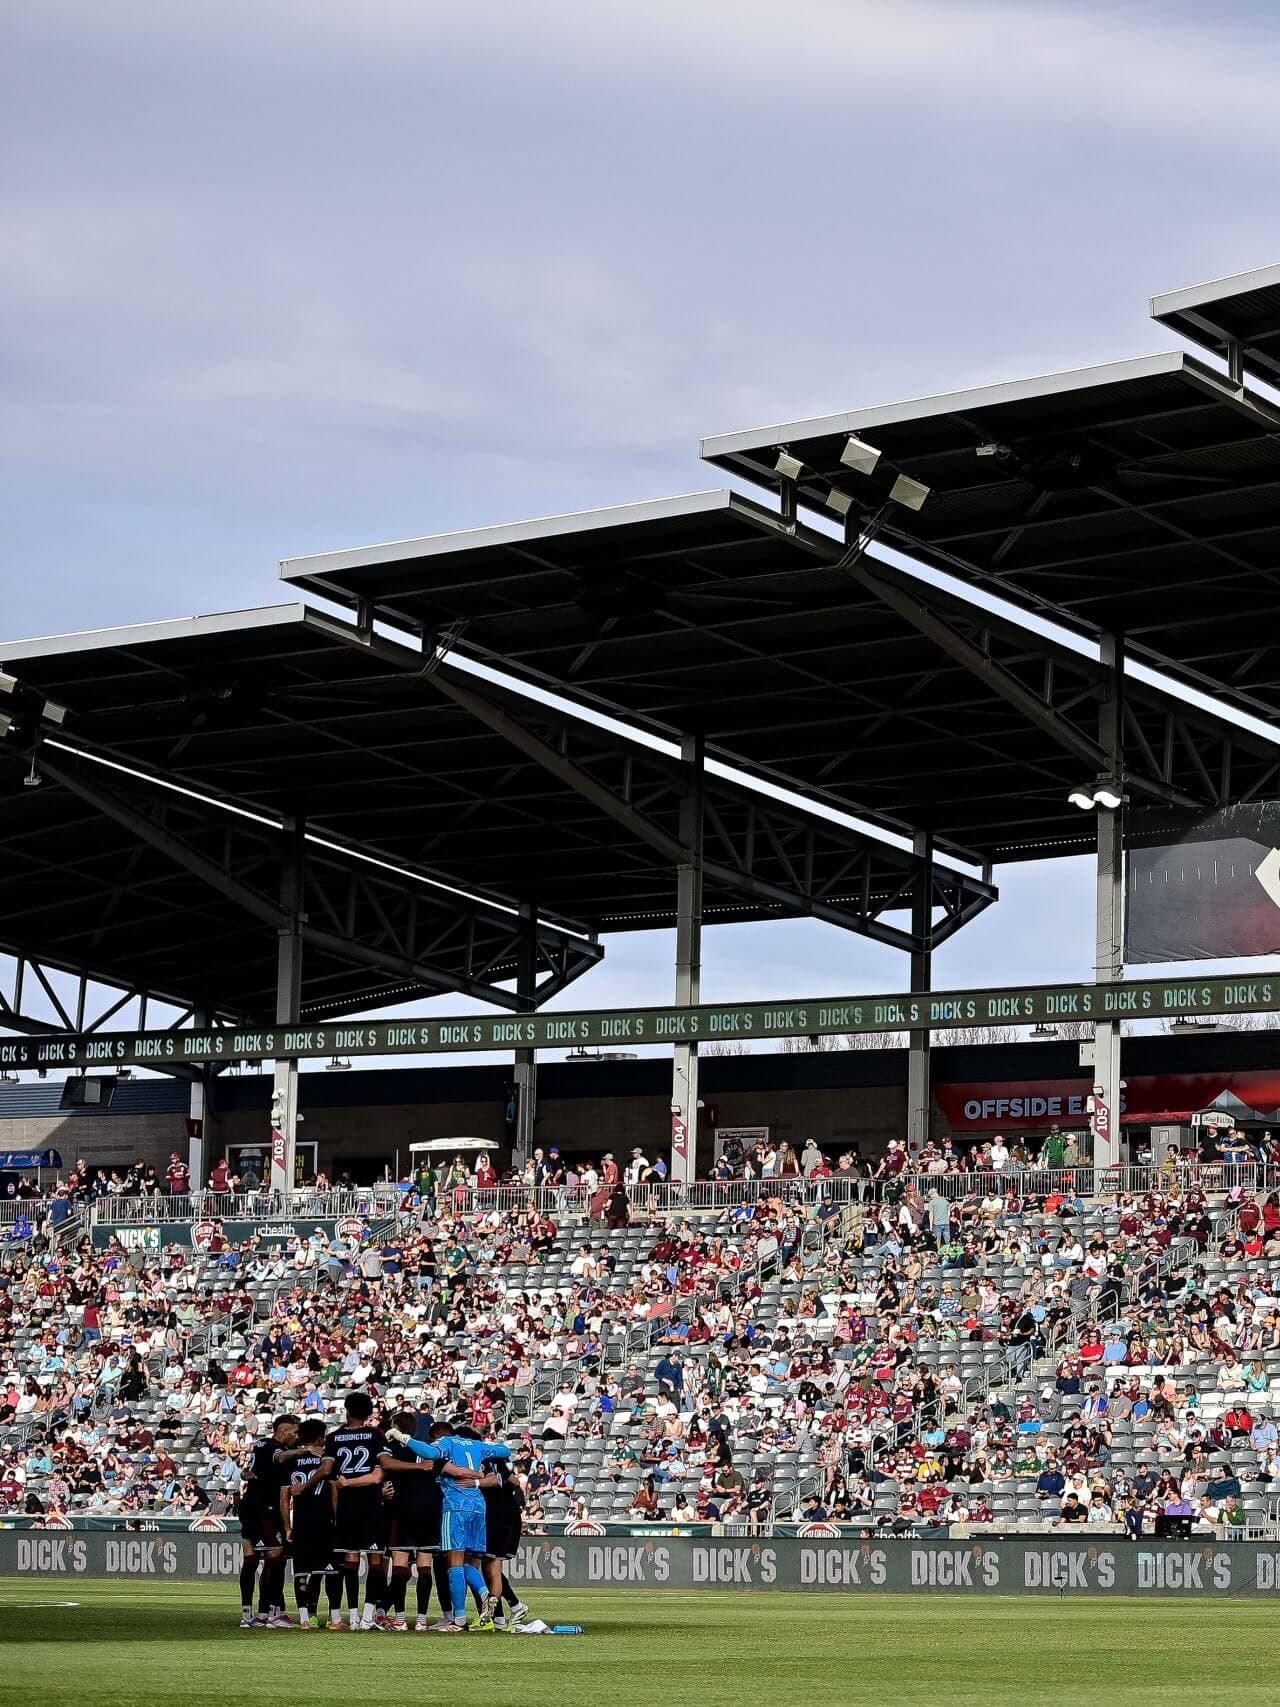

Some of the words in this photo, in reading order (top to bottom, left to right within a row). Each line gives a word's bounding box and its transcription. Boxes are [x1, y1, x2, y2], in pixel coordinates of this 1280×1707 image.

[38, 1043, 76, 1061] DICKS
[86, 1041, 124, 1059] DICKS
[135, 1039, 173, 1057] DICKS
[184, 1037, 222, 1055] DICKS
[234, 1034, 273, 1053] DICKS
[285, 1032, 324, 1051] DICKS
[336, 1030, 376, 1049] DICKS
[388, 1027, 428, 1046] DICKS
[440, 1025, 480, 1044] DICKS
[493, 1023, 534, 1042] DICKS
[547, 1020, 588, 1040] DICKS
[601, 1017, 643, 1037] DICKS
[656, 1015, 698, 1035] DICKS
[710, 1012, 752, 1032] DICKS
[875, 1003, 918, 1024] DICKS
[931, 1000, 974, 1021] DICKS
[988, 997, 1032, 1017] DICKS
[1046, 993, 1090, 1014] DICKS
[1105, 990, 1150, 1011] DICKS
[1164, 987, 1210, 1008] DICKS
[1225, 984, 1271, 1005] DICKS
[964, 1097, 1062, 1120] OFFSIDE
[1097, 1108, 1108, 1131] 105
[674, 1125, 685, 1149] 104
[274, 1139, 285, 1160] 103
[297, 1457, 320, 1467] TRAVIS
[337, 1445, 371, 1474] 22
[18, 1536, 87, 1571] DICK'S
[106, 1536, 177, 1573] DICK'S
[197, 1541, 243, 1574] DICK
[503, 1541, 566, 1580] CK'S
[588, 1542, 670, 1581] DICK'S
[693, 1543, 777, 1582] DICK'S
[801, 1544, 887, 1584] DICK'S
[912, 1545, 999, 1586] DICK'S
[1024, 1546, 1115, 1588] DICK'S
[1138, 1547, 1231, 1589] DICK'S
